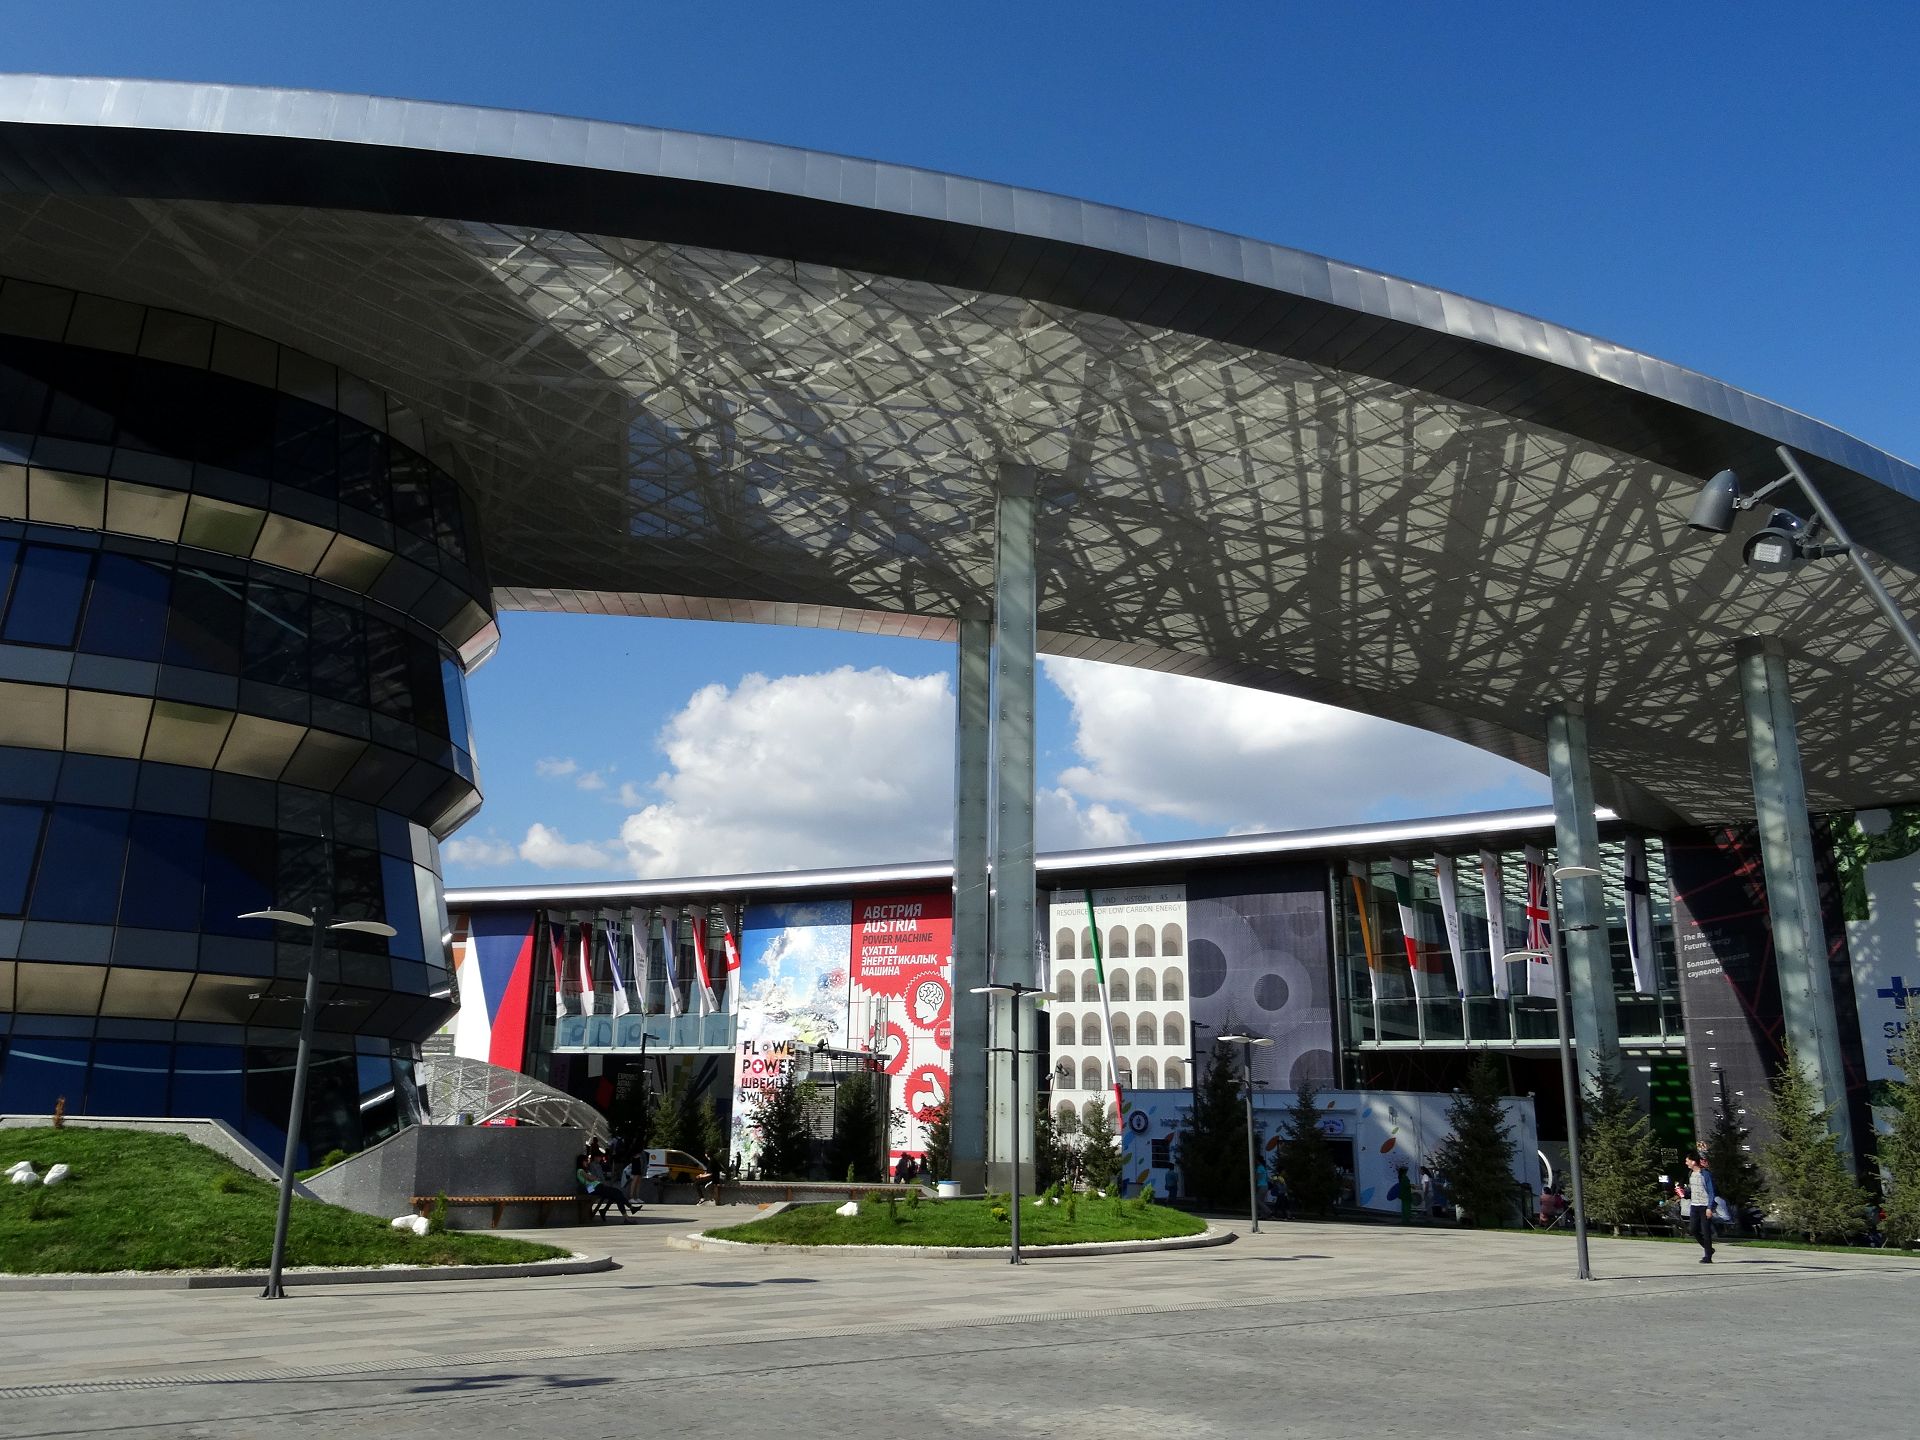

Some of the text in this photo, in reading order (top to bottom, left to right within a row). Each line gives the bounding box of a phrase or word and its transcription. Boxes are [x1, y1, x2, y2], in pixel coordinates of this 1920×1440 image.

[863, 903, 922, 919] АВСТРИЯ
[862, 919, 917, 934] AUSTRIA
[862, 932, 933, 944] POWER MACHINE
[1683, 934, 1695, 942] The
[862, 945, 898, 956] ҚУАТТЫ
[1684, 942, 1707, 951] Future
[861, 954, 938, 966] ЭНЕРГЕТИКАЛЫҚ
[861, 966, 900, 976] МАШИНА
